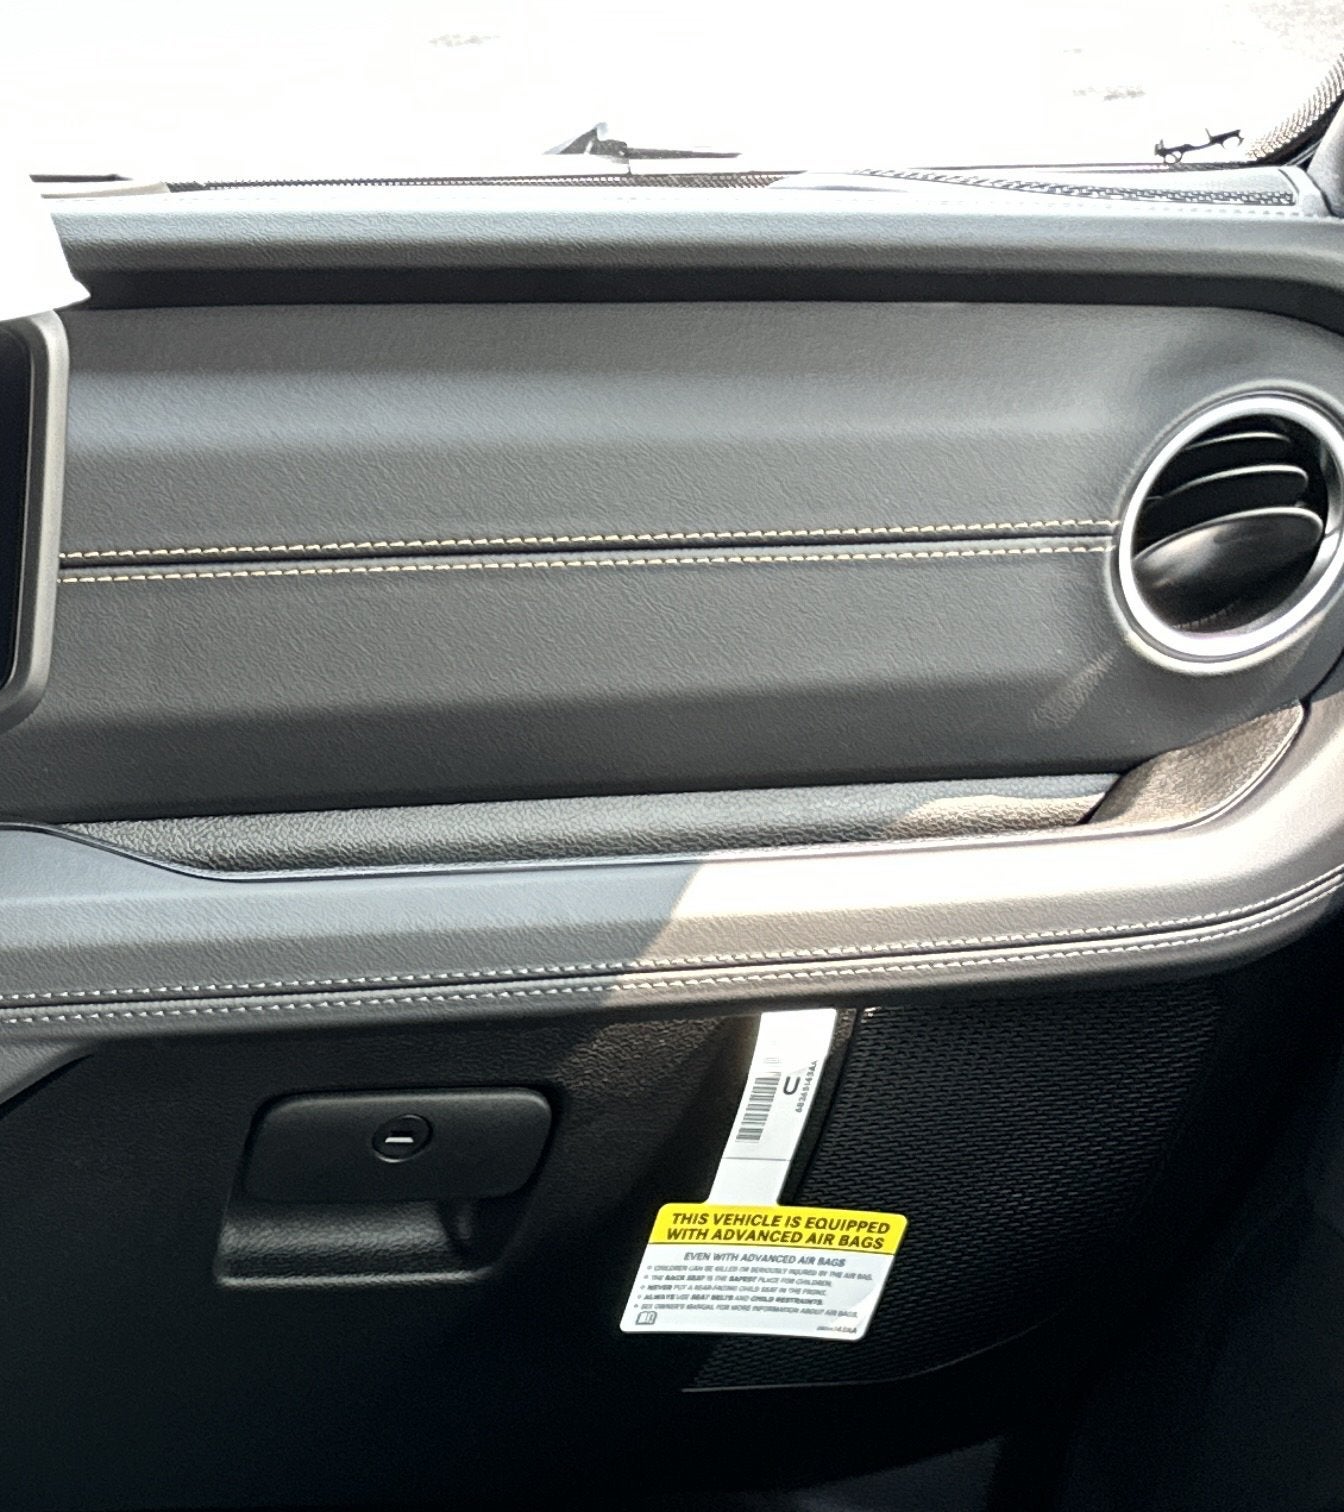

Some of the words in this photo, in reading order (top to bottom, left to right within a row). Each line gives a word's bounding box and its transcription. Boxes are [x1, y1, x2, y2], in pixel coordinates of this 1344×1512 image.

[783, 1075, 801, 1096] U
[672, 1212, 709, 1225] THIS
[713, 1213, 782, 1228] VEHICLE
[784, 1216, 802, 1229] IS
[804, 1217, 891, 1234] EQUIPPED
[667, 1228, 709, 1241] WITH
[711, 1228, 803, 1243] ADVANCED
[805, 1232, 835, 1246] AIR
[838, 1235, 885, 1250] BAGS
[683, 1252, 711, 1261] EVEN
[713, 1252, 738, 1262] WITH
[740, 1253, 797, 1264] ADVANCED
[798, 1256, 816, 1265] AIR
[817, 1257, 846, 1267] BAGS
